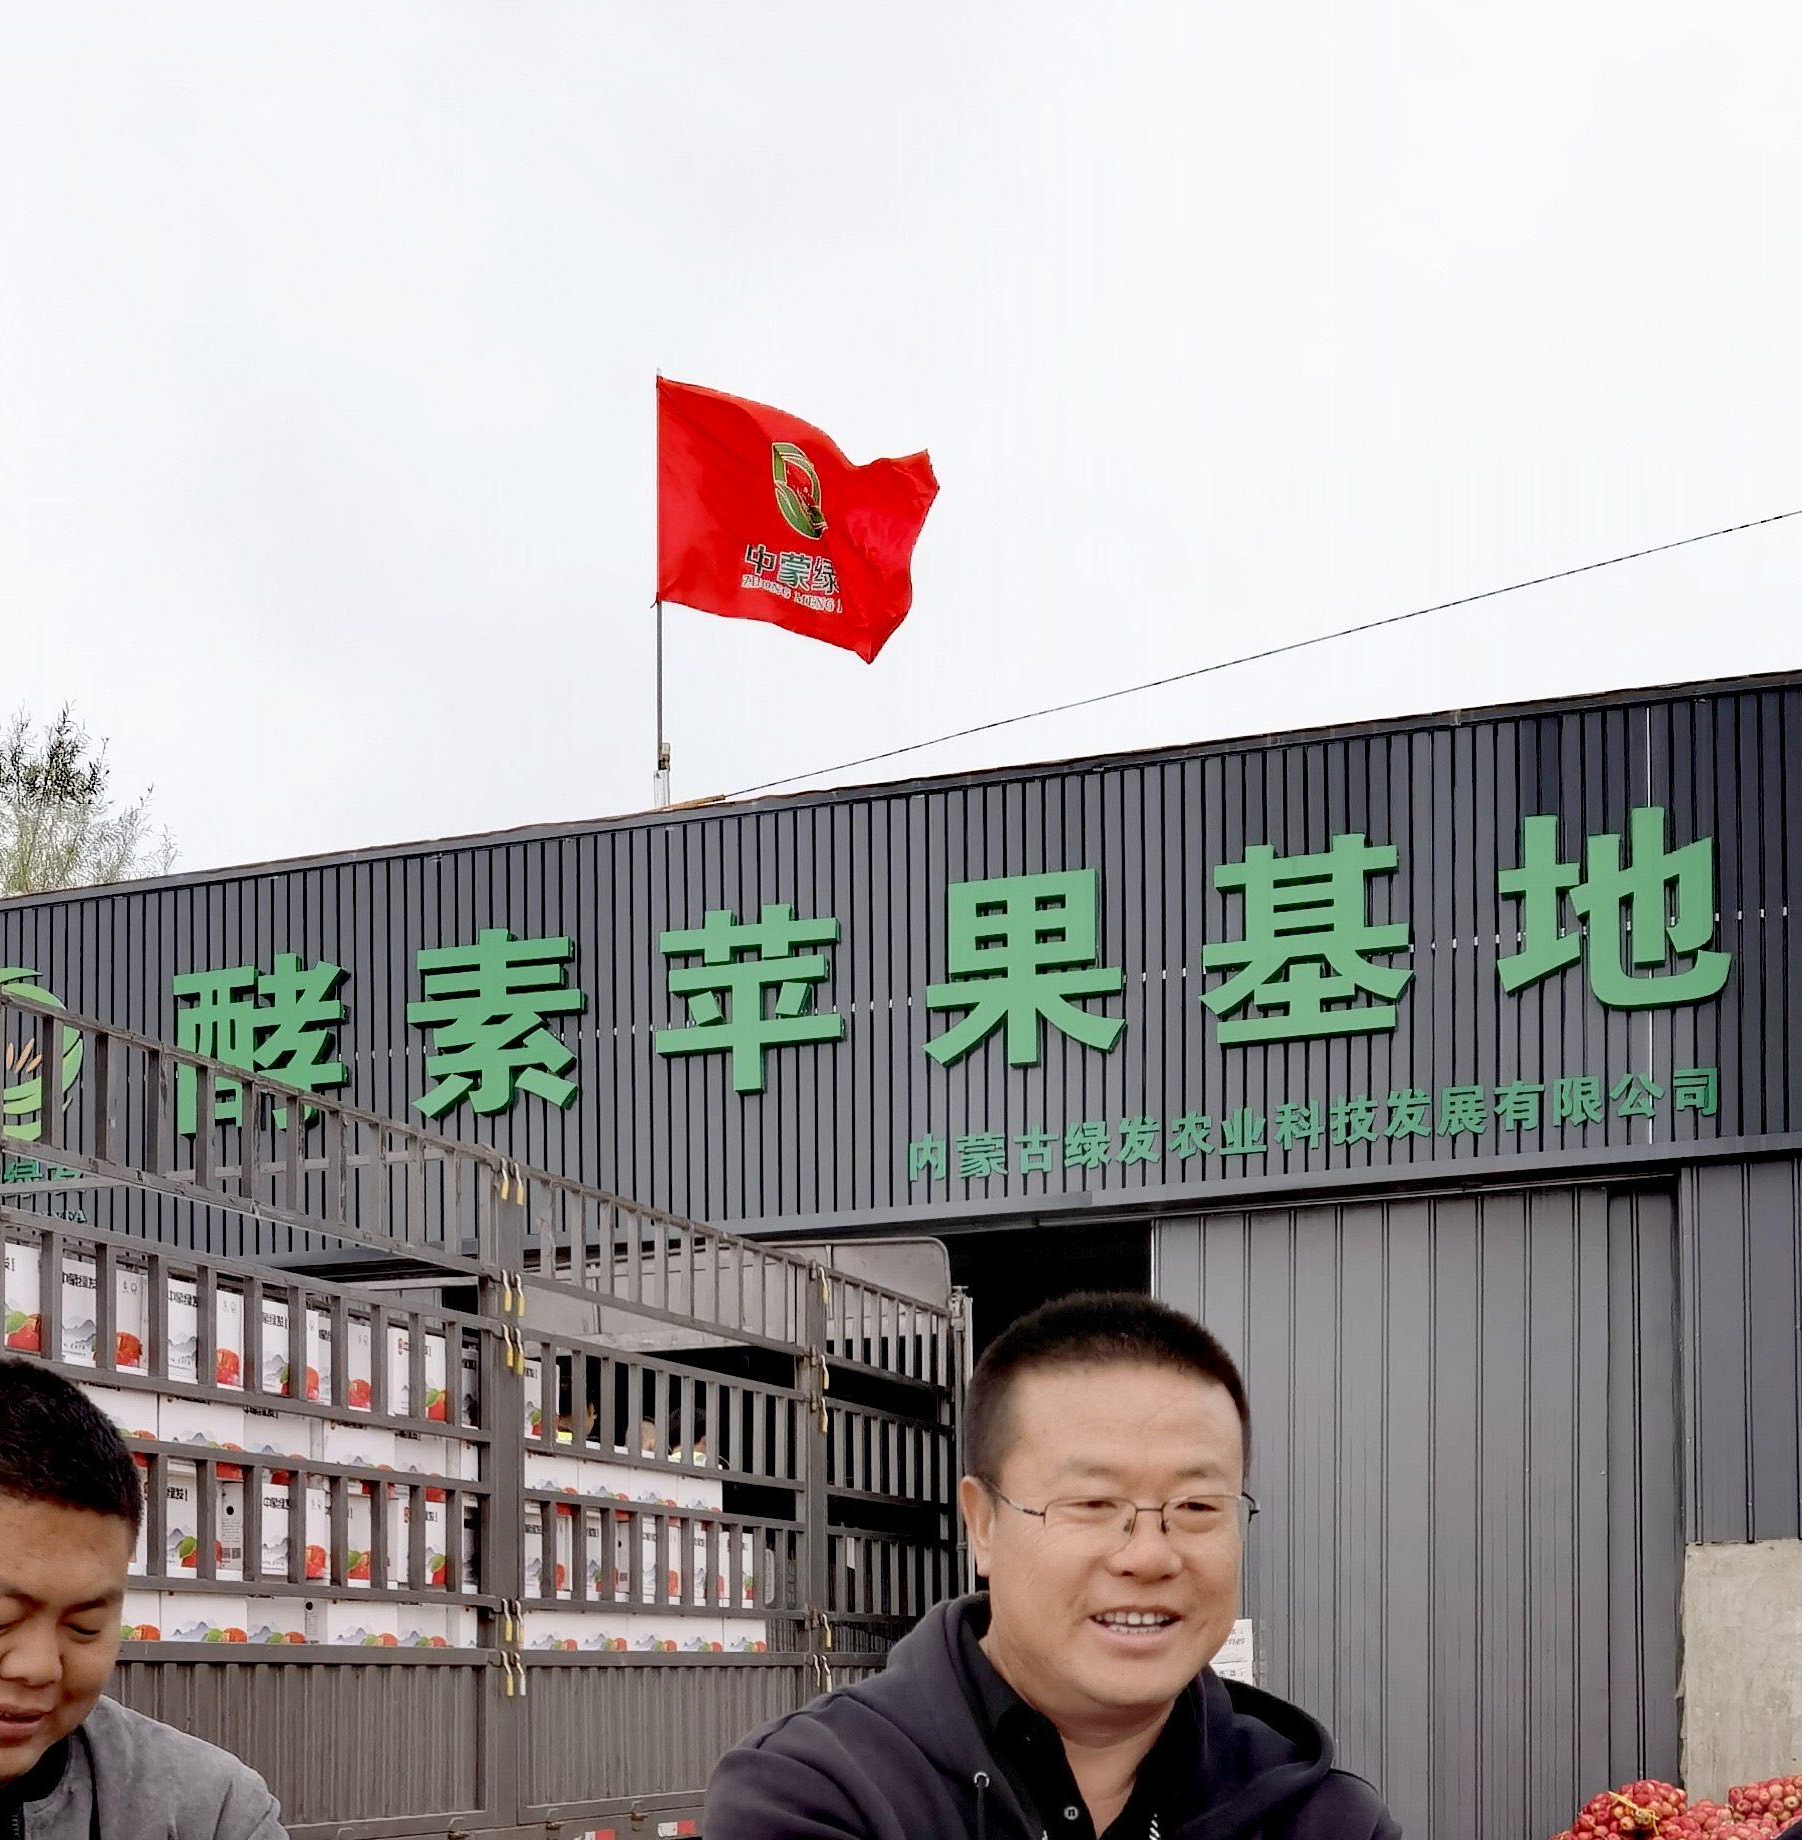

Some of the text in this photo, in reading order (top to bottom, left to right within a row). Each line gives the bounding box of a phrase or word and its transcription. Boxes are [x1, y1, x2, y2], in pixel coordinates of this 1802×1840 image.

[173, 806, 1733, 1138] 酵素苹果基地
[908, 1067, 1720, 1183] 内蒙古绿发农业科技发展有限公司
